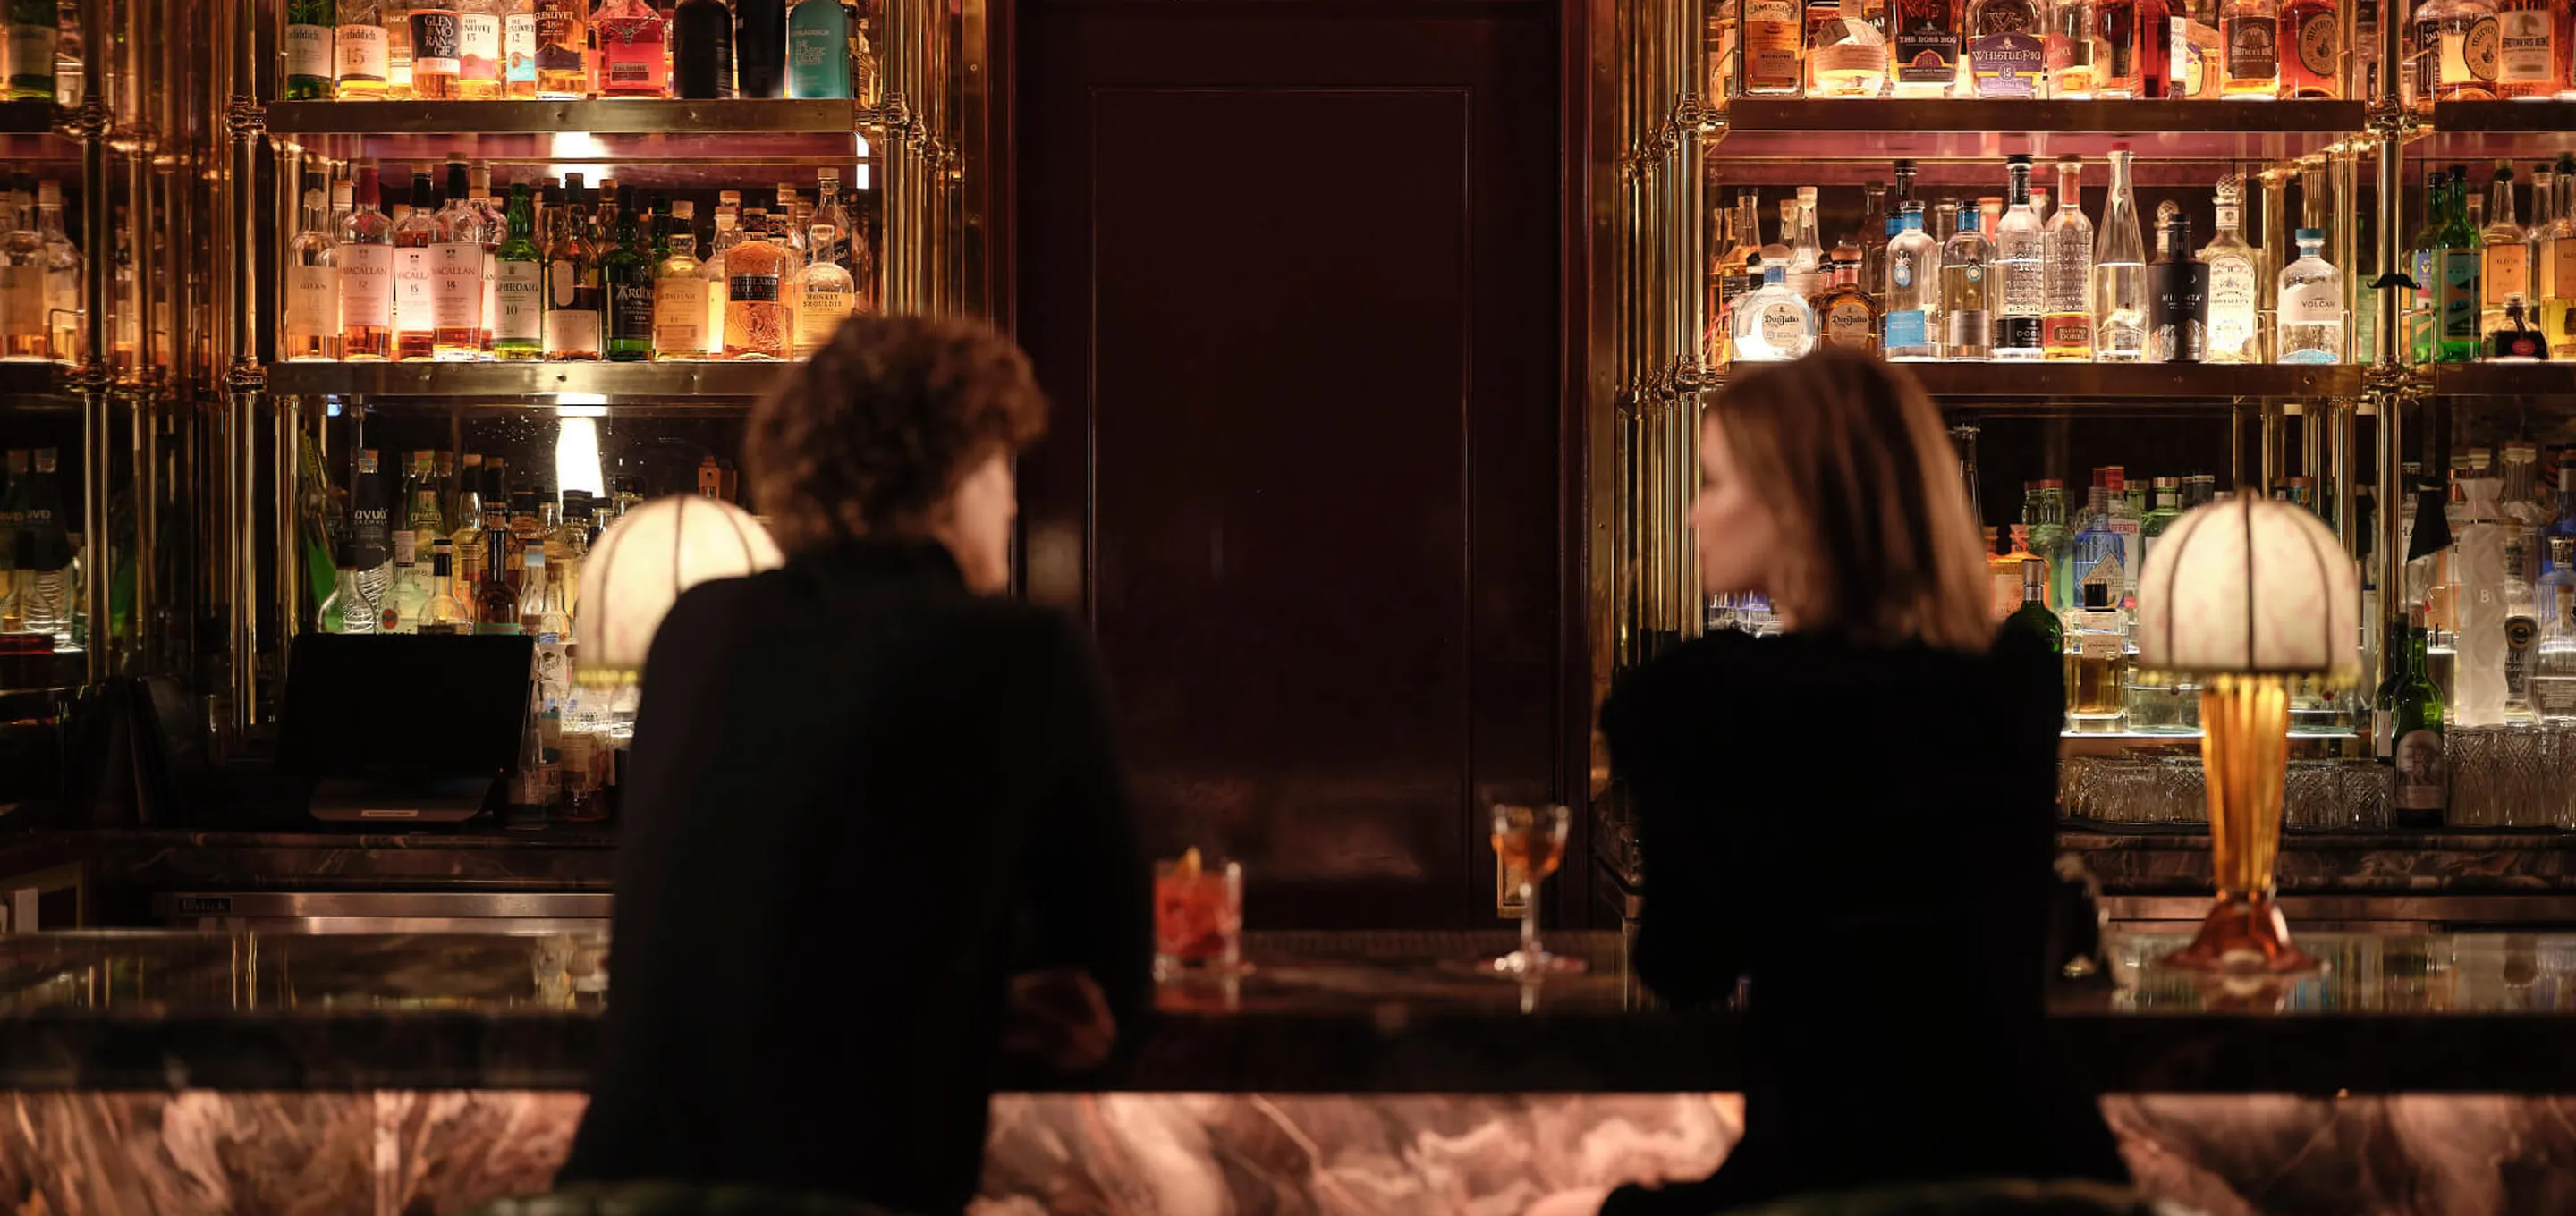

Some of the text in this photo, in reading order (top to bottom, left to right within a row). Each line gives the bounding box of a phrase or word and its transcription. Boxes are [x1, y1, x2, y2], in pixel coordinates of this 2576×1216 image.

[424, 16, 453, 27] GLEN
[425, 36, 447, 46] RAN
[1899, 36, 1916, 44] THE
[434, 46, 451, 56] GIE
[730, 277, 778, 285] HIGHLAND
[505, 305, 518, 315] 10
[2479, 589, 2490, 604] B
